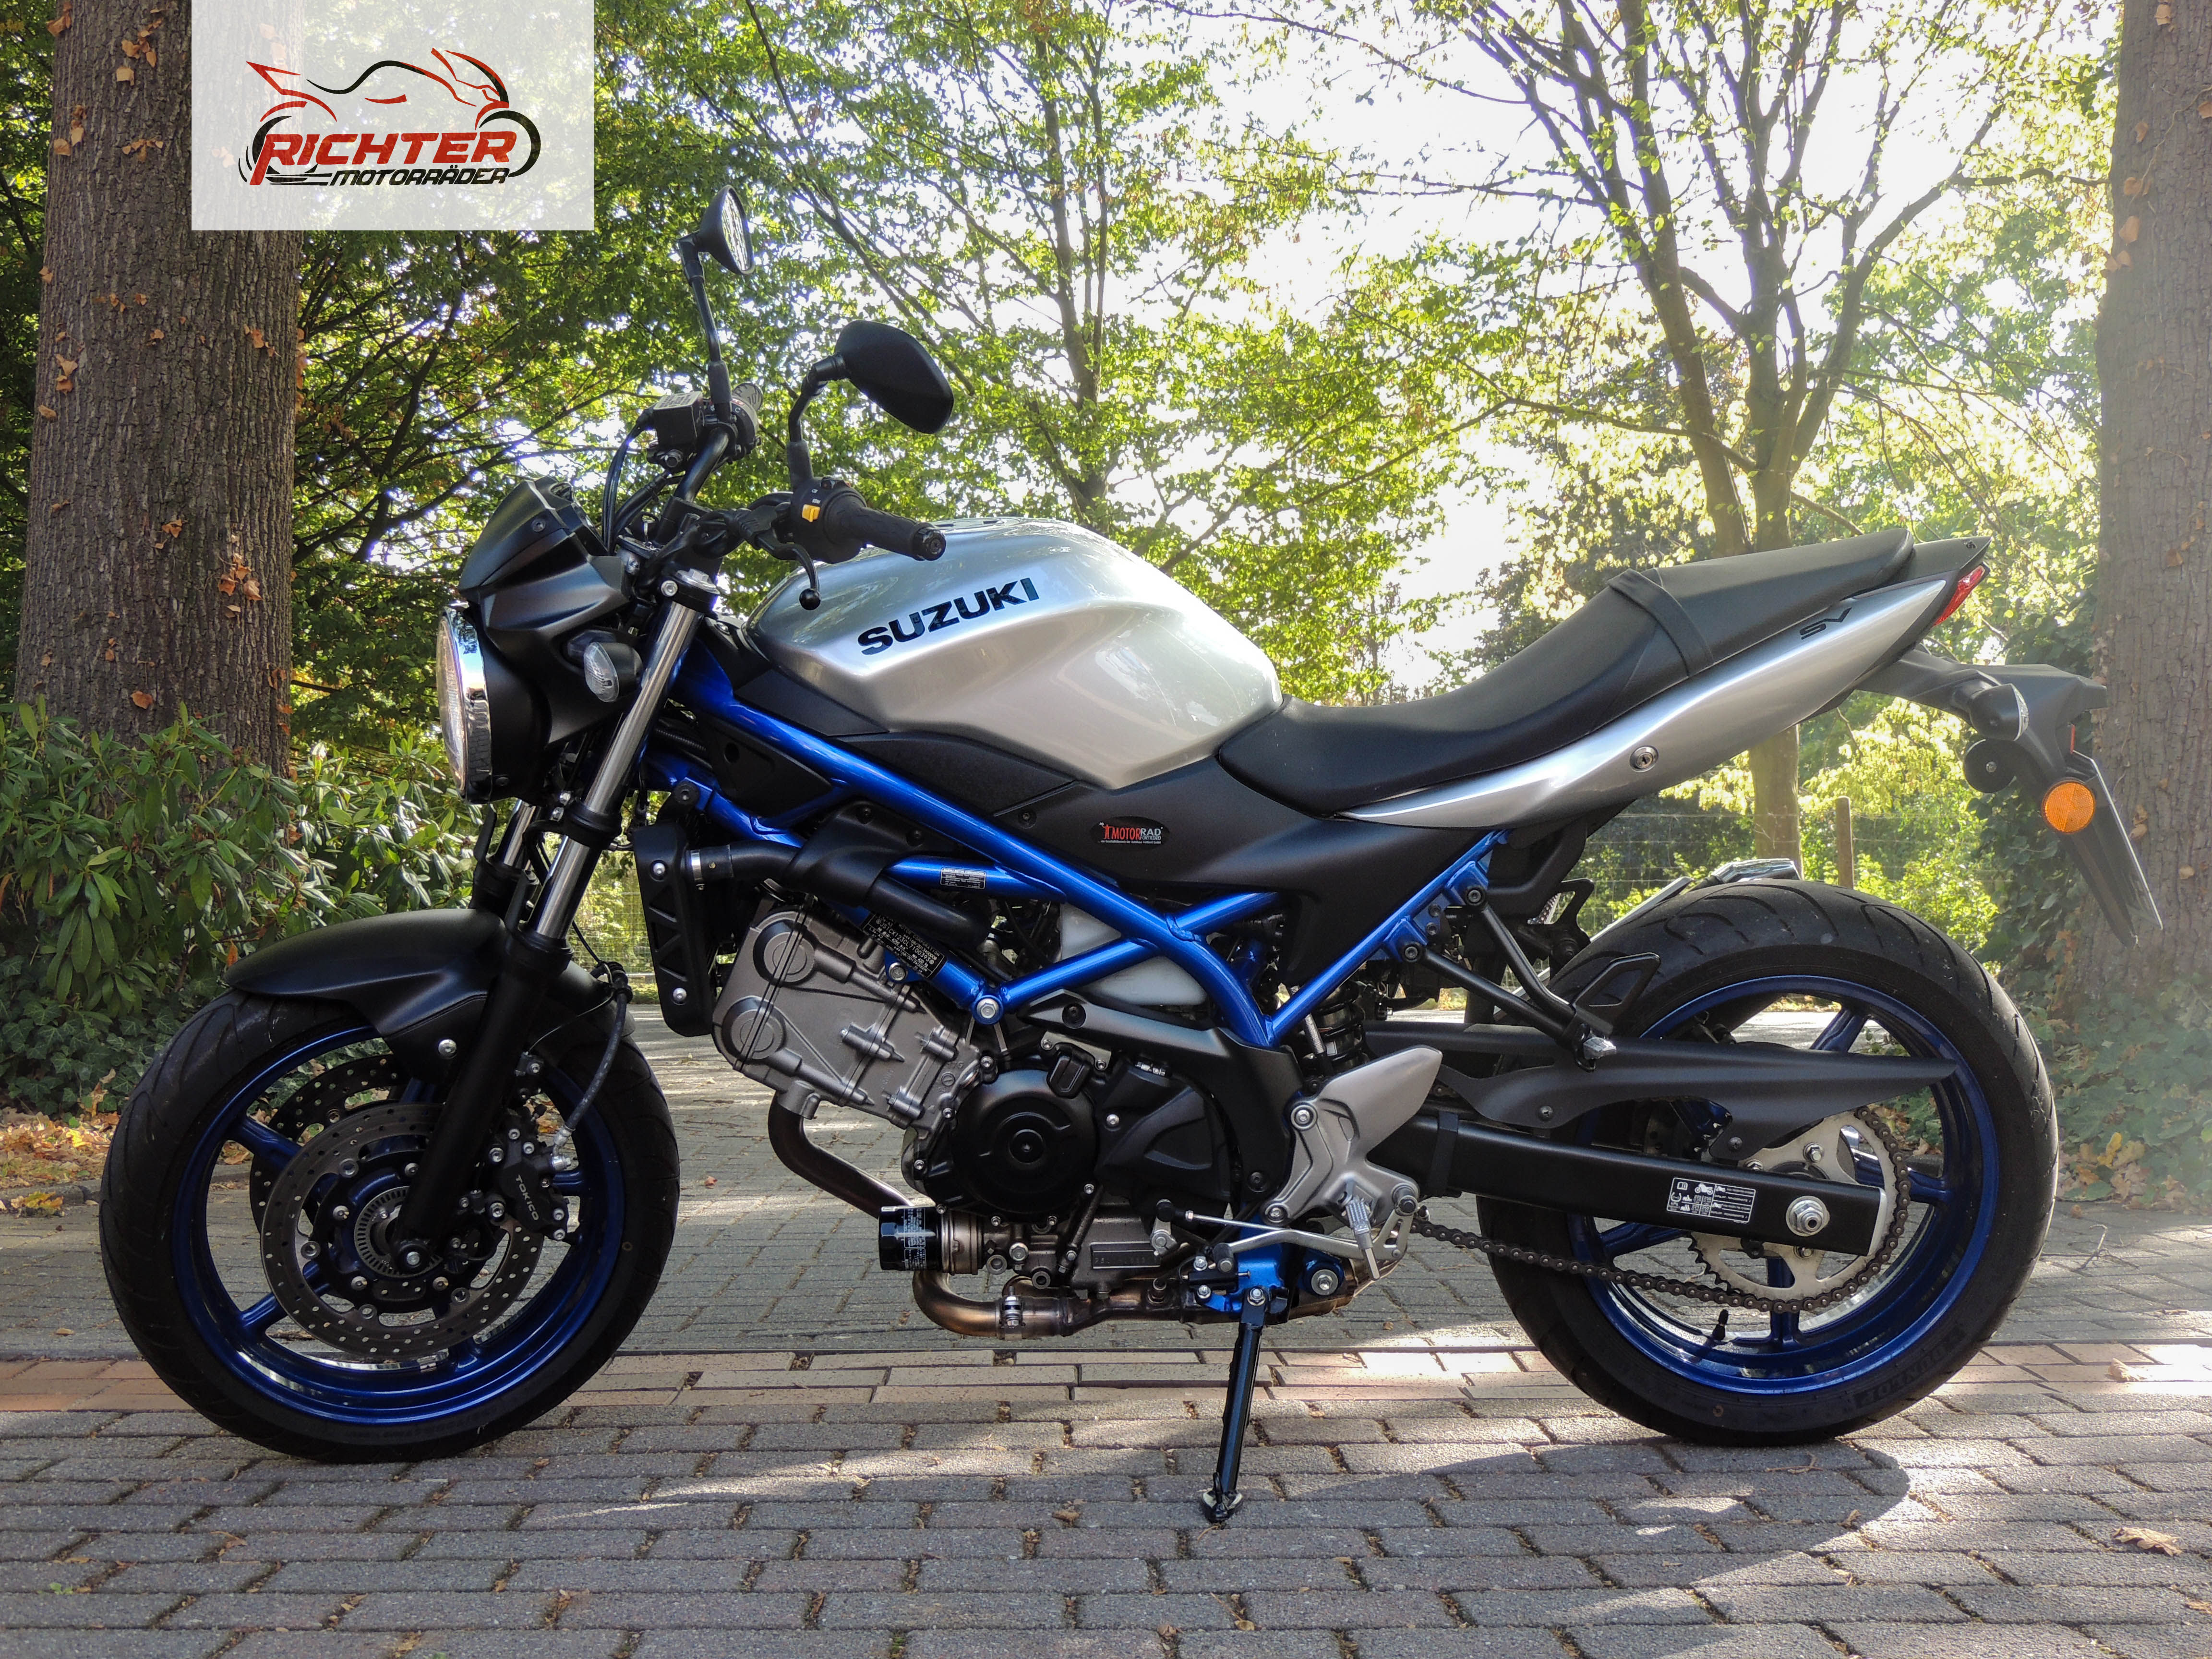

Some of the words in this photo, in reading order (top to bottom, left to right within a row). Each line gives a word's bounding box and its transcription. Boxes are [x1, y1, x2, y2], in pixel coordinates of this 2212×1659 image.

[857, 577, 1039, 656] SUZUKI
[1799, 607, 1852, 640] SV
[515, 1175, 539, 1220] TOKICO
